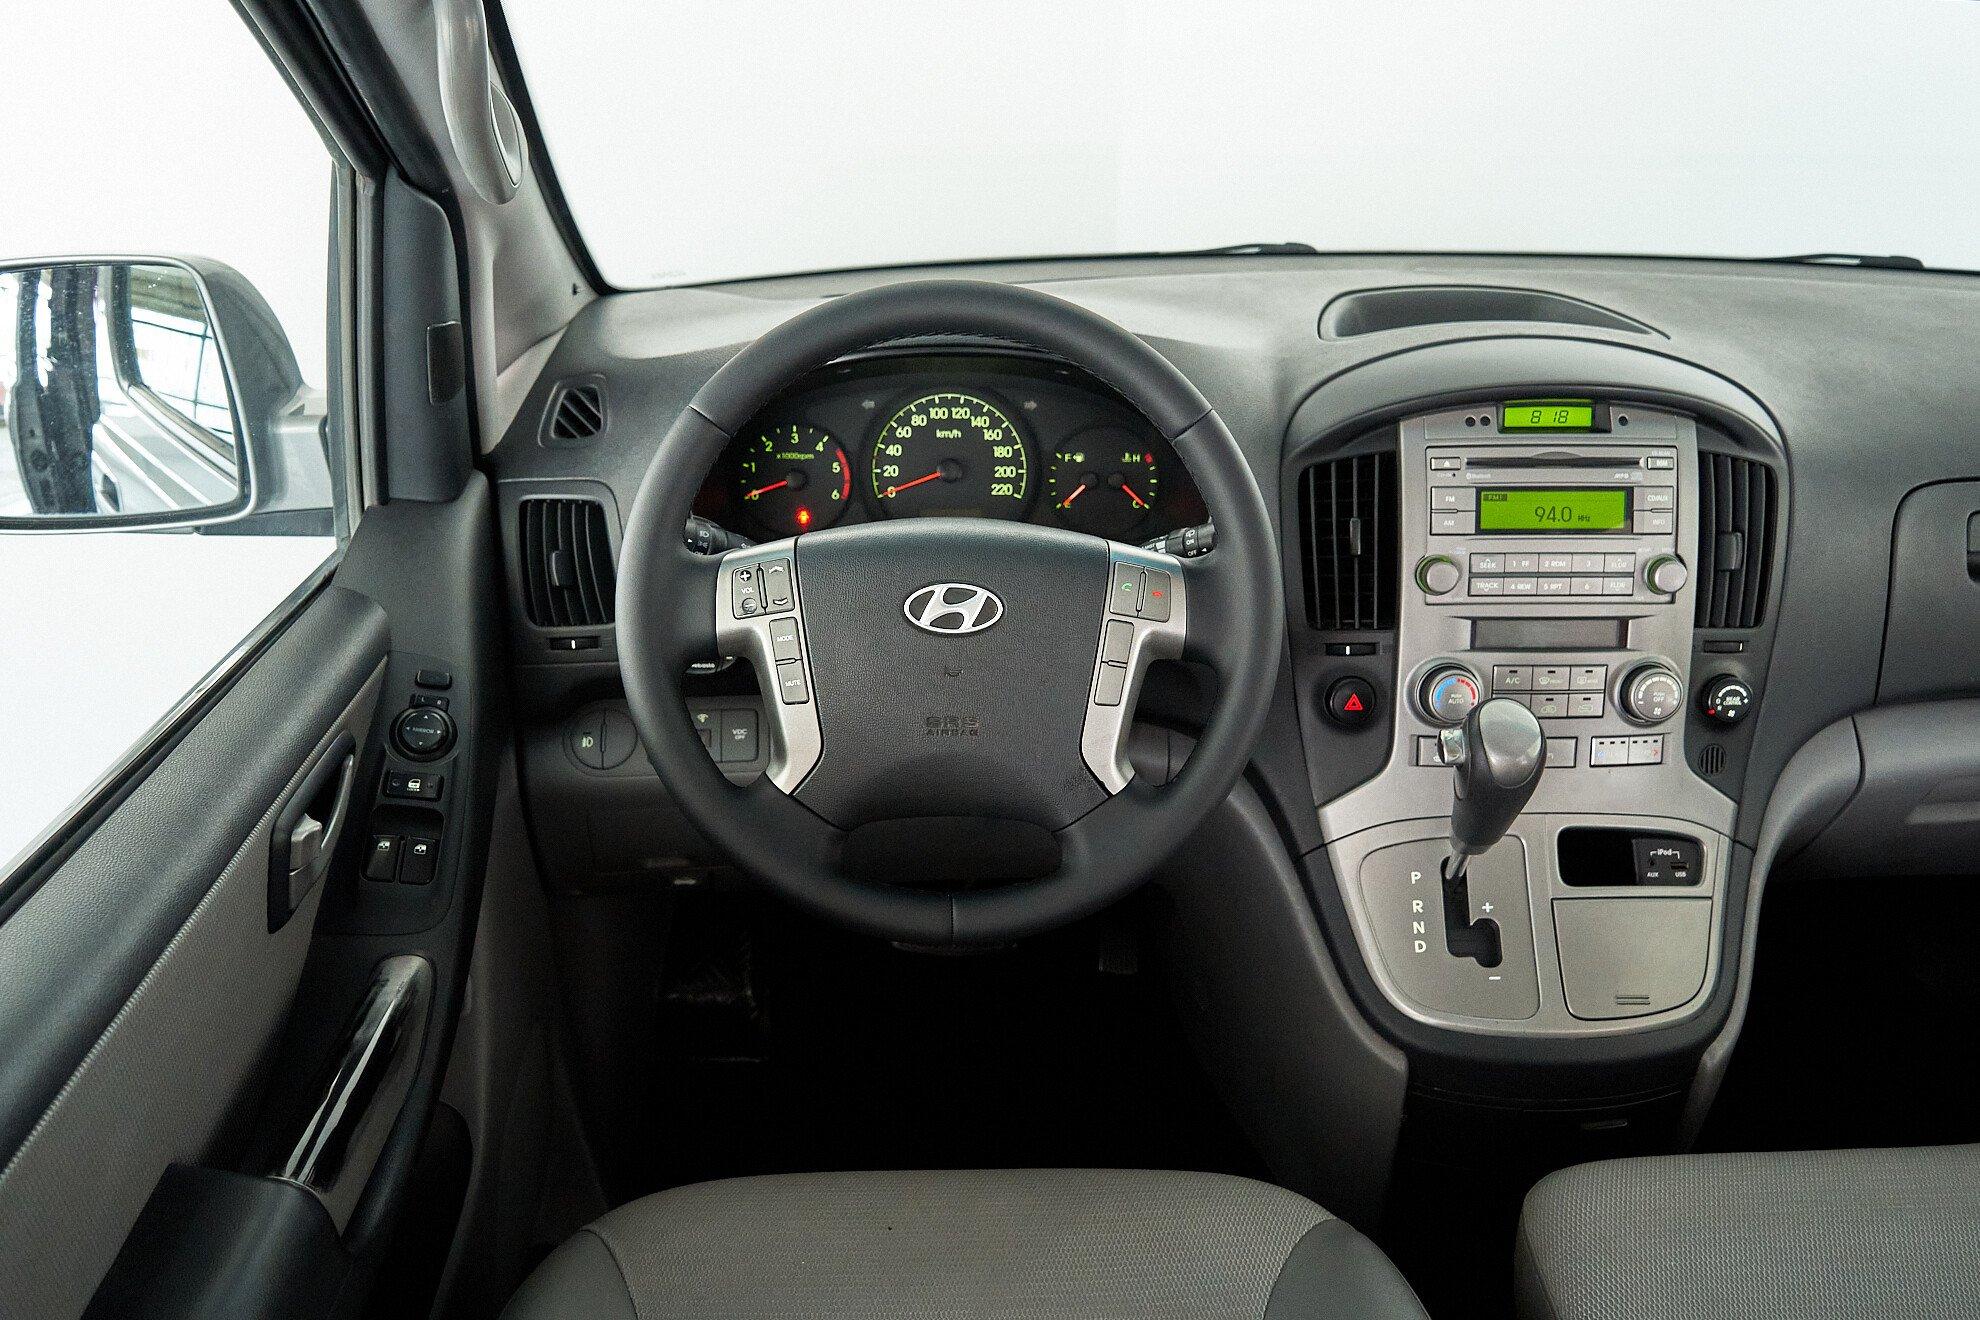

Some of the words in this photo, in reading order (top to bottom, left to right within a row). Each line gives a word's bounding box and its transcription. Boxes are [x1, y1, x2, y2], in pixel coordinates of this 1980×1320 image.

[929, 407, 949, 419] 100
[951, 407, 970, 419] 120
[911, 414, 927, 427] 80
[971, 416, 990, 428] 140
[895, 426, 912, 438] 60
[936, 429, 961, 439] km/h
[983, 428, 1002, 441] 160
[790, 433, 799, 444] 3
[765, 441, 773, 452] 2
[815, 441, 824, 452] 4
[885, 444, 902, 456] 40
[993, 446, 1013, 458] 180
[1064, 453, 1071, 462] F
[1132, 454, 1140, 462] H
[750, 462, 756, 473] 1
[832, 462, 840, 473] 5
[882, 465, 899, 477] 20
[994, 466, 1016, 478] 200
[831, 489, 840, 500] 6
[991, 484, 1013, 496] 220
[1535, 506, 1572, 522] 94.0
[741, 586, 755, 594] VOL
[784, 679, 801, 687] MUTE
[1657, 848, 1672, 856] iPod
[1411, 871, 1422, 884] P
[1412, 900, 1424, 913] R
[1413, 921, 1425, 934] N
[1414, 940, 1426, 953] D
